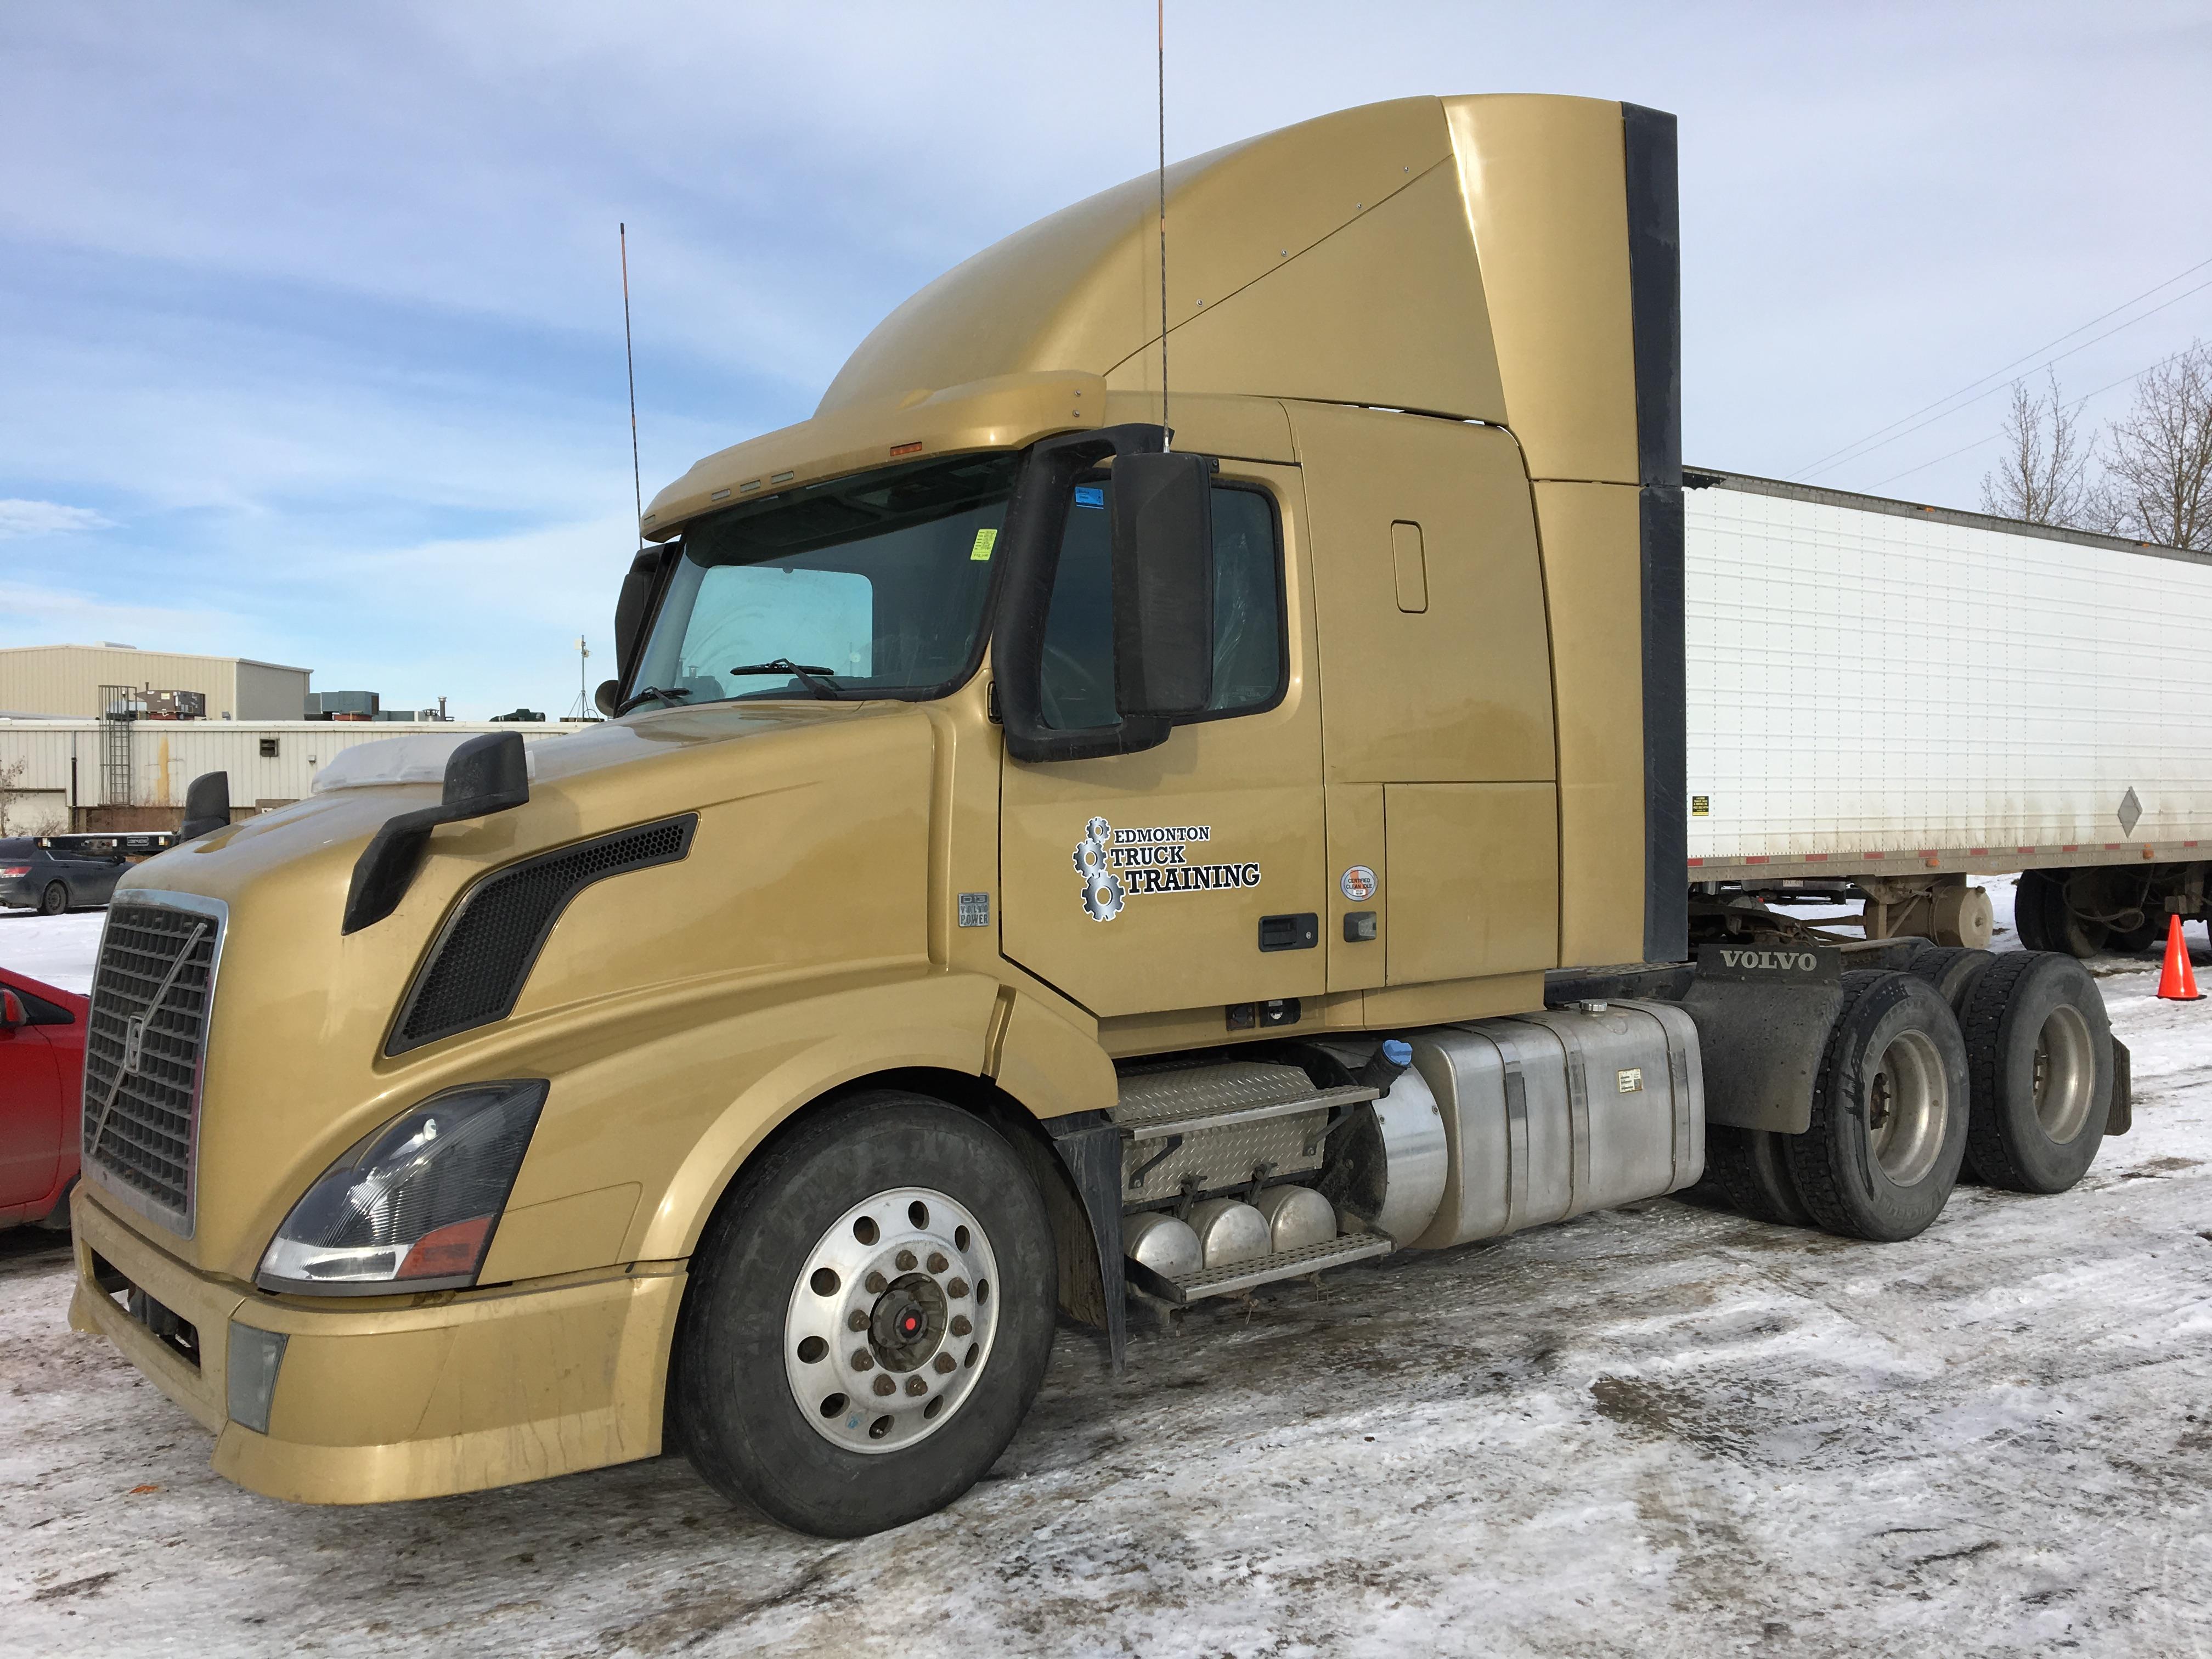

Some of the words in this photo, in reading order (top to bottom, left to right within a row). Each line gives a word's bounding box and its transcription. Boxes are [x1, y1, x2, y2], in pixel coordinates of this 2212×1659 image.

[1114, 826, 1210, 843] EDMONTON
[1110, 845, 1186, 866] TRUCK
[1125, 864, 1260, 894] TRAINING
[961, 905, 988, 913] VOLVO
[961, 914, 988, 924] POWER
[1720, 950, 1817, 971] VOLVO
